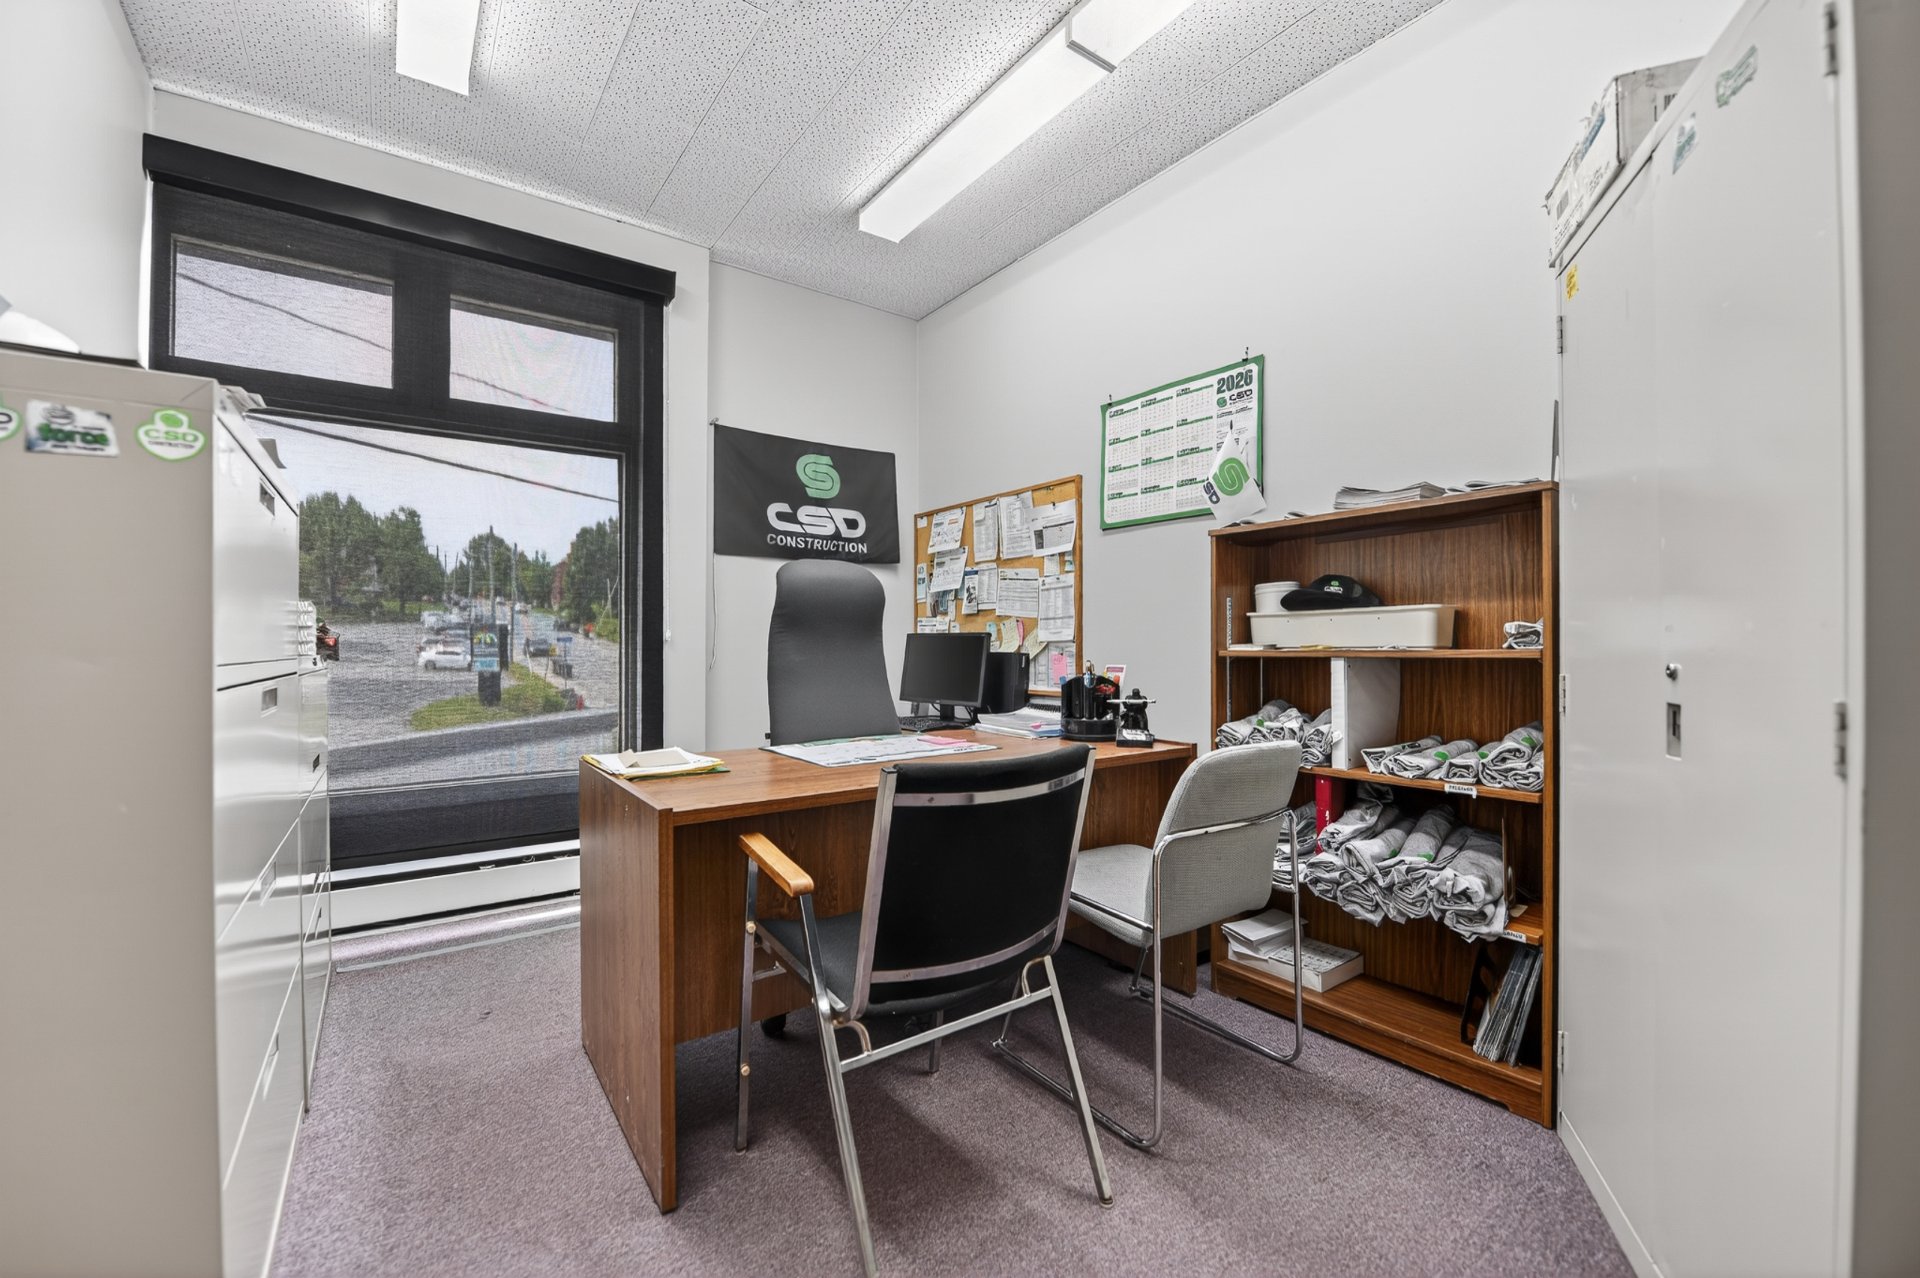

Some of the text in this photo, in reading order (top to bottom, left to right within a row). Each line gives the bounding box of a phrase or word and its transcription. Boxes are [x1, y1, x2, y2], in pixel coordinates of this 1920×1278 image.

[1216, 369, 1253, 395] 2026
[1229, 389, 1253, 401] CSD
[144, 429, 199, 443] CSD
[1203, 480, 1221, 505] SD
[767, 502, 867, 538] CSD
[767, 533, 868, 554] CONSTRUCTION
